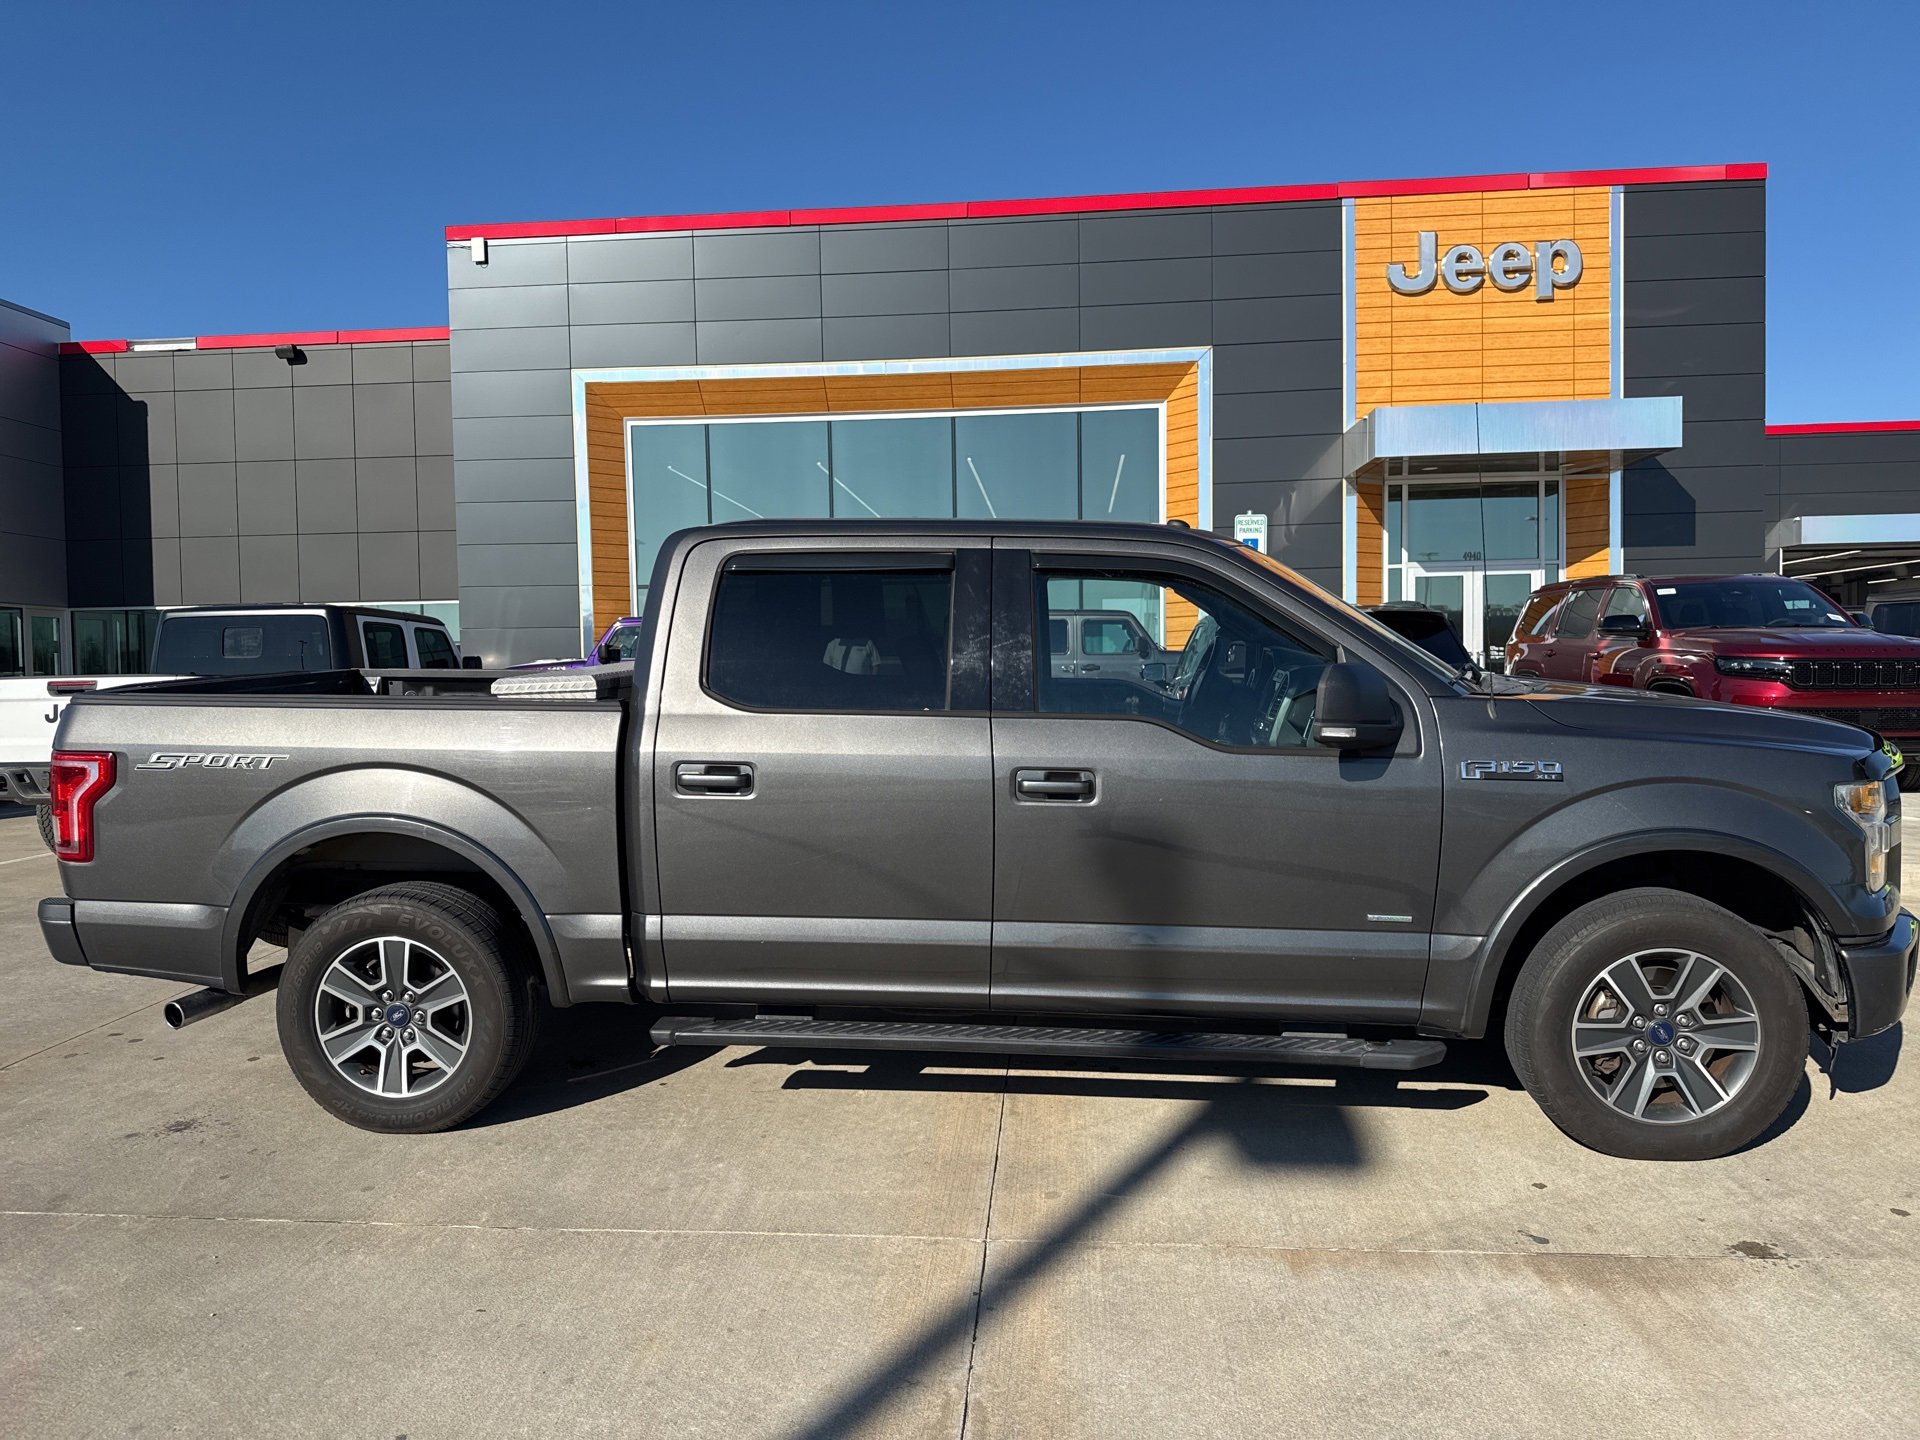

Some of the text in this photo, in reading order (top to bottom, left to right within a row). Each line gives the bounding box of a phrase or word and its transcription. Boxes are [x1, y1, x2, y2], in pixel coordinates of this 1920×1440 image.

[1387, 230, 1583, 303] Jeep
[1462, 551, 1482, 561] 4940
[134, 752, 290, 771] SPORT
